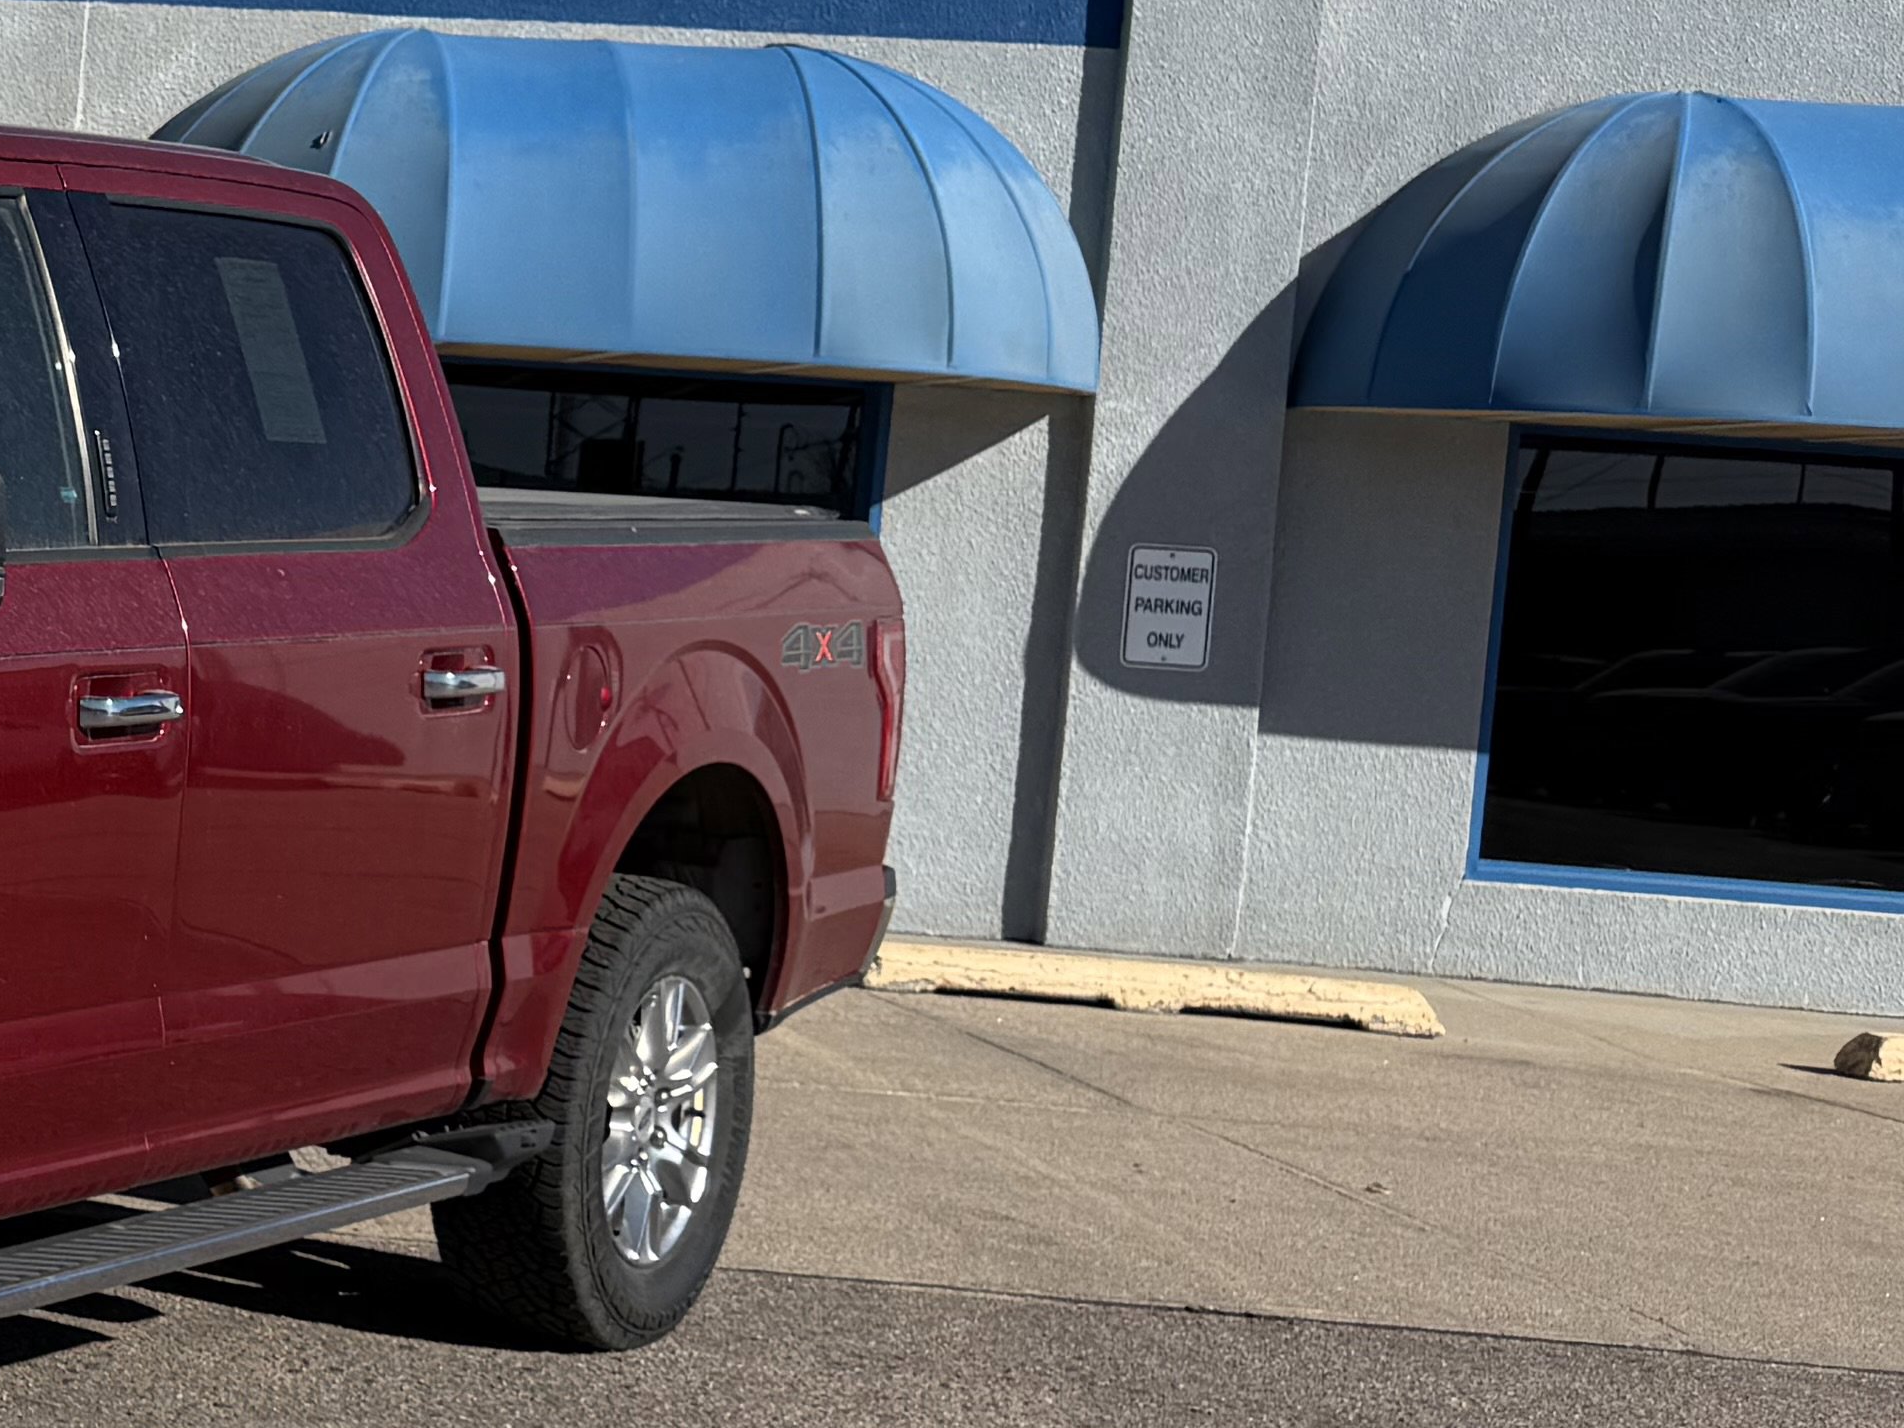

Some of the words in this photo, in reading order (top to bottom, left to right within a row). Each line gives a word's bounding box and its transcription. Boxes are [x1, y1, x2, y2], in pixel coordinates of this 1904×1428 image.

[1134, 563, 1209, 584] CUSTOMER
[1134, 597, 1203, 617] PARKING
[1146, 631, 1185, 649] ONLY
